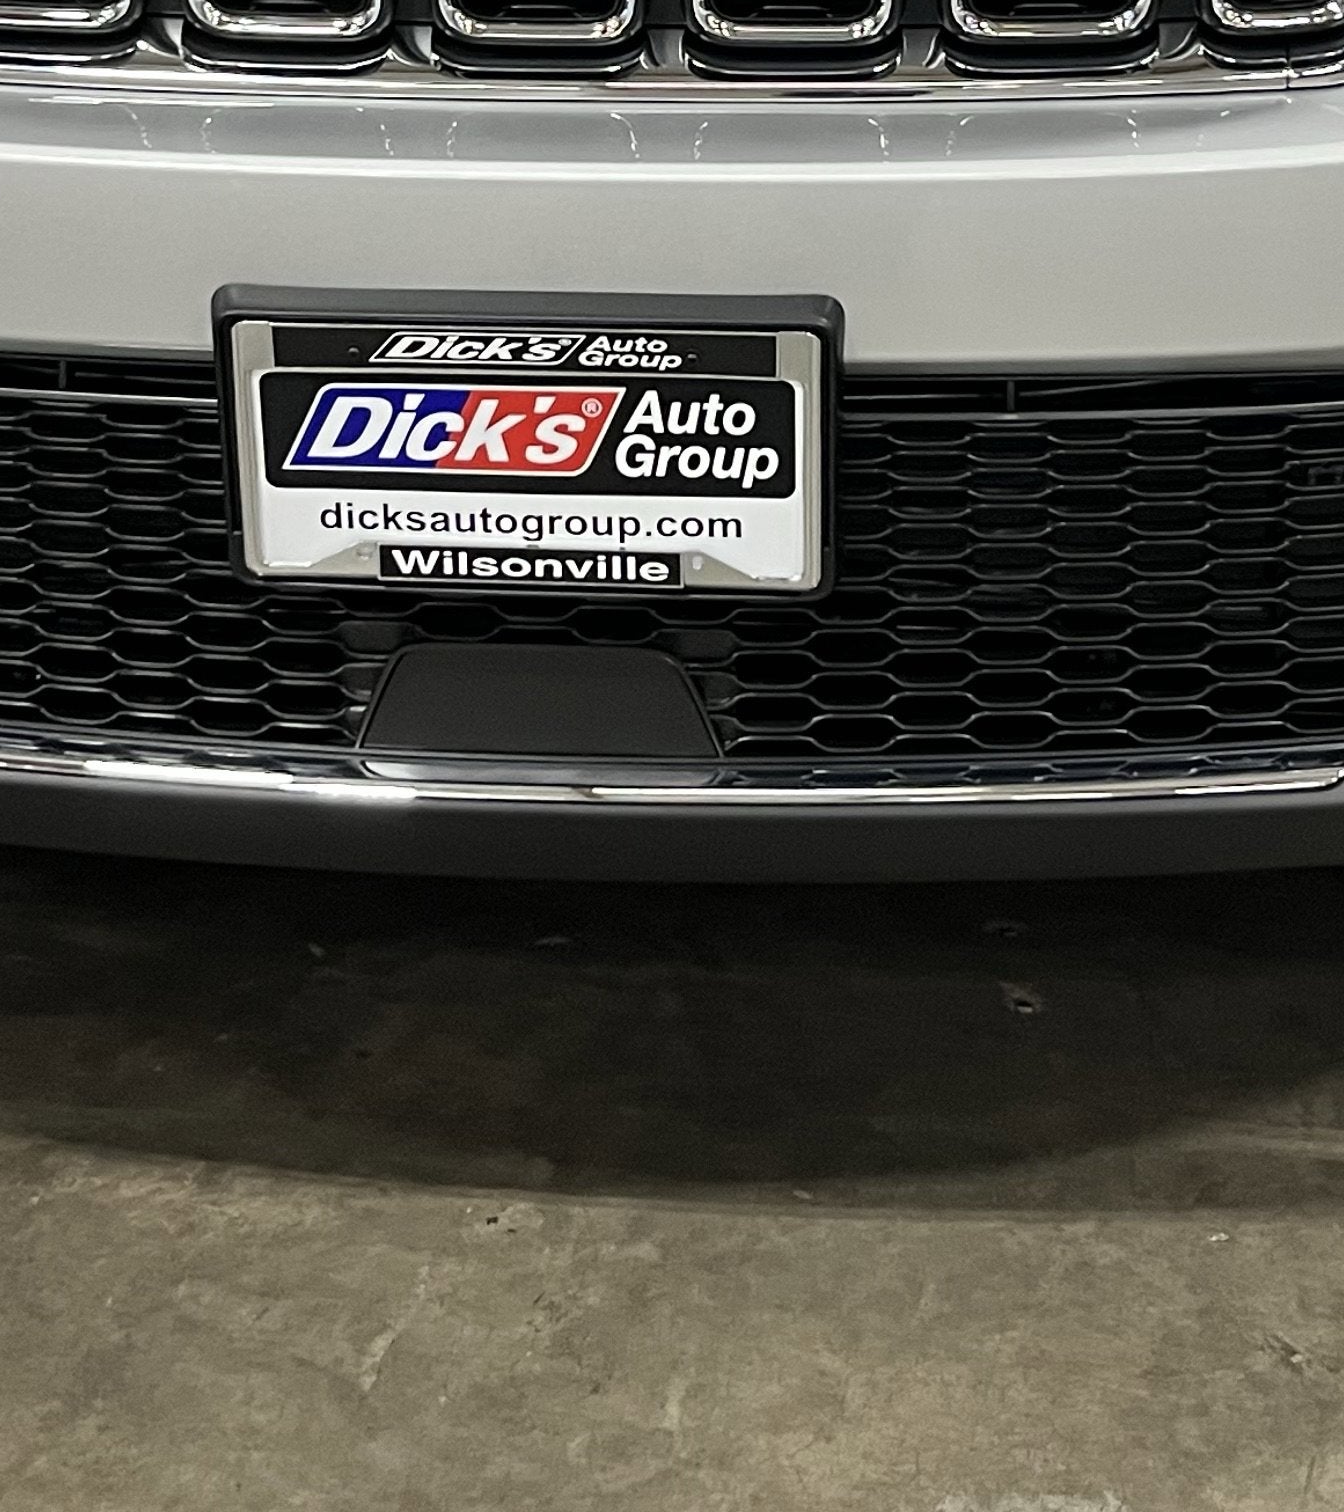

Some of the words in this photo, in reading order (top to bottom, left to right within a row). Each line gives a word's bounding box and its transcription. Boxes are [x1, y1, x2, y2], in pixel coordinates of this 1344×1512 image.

[578, 350, 683, 371] Group
[586, 335, 668, 353] Auto
[623, 389, 756, 436] Auto
[615, 433, 779, 489] Group
[319, 502, 743, 543] dicksautogroup.com
[391, 548, 670, 582] Wilsonville
